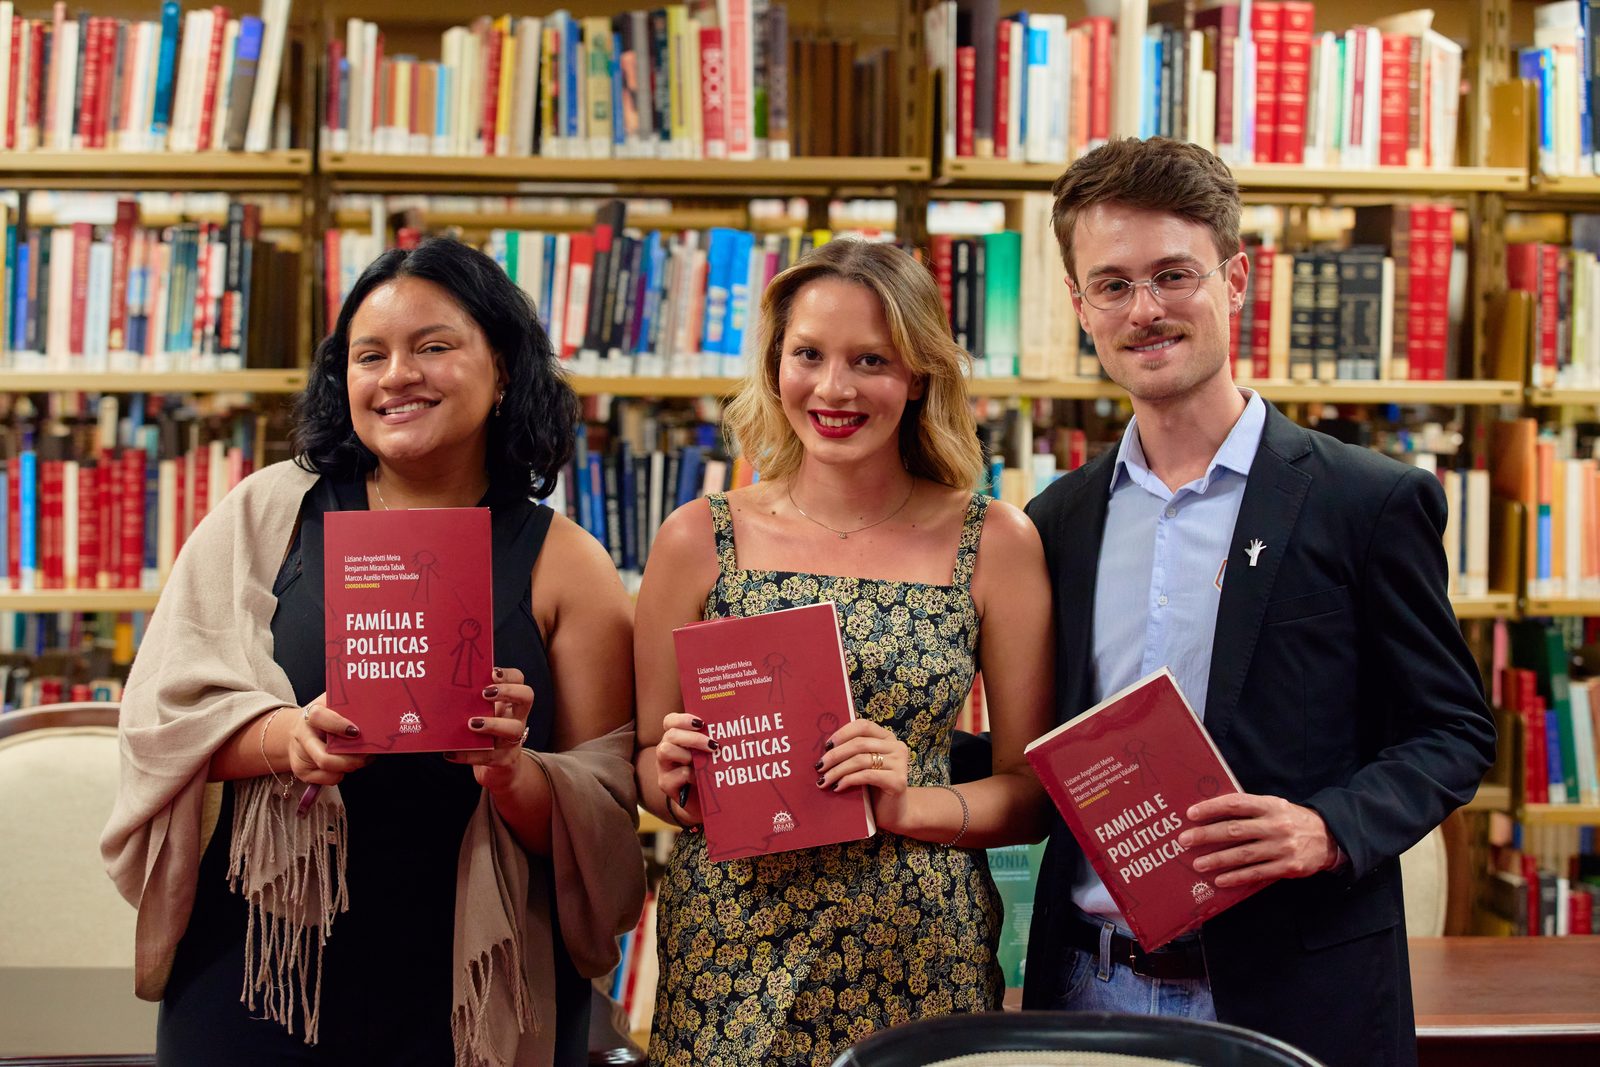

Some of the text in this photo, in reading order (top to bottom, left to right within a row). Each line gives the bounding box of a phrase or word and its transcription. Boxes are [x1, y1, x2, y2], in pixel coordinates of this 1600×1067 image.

[345, 565, 368, 573] Benjamin
[363, 555, 385, 563] Angelotti
[363, 573, 381, 581] Aurélio
[399, 572, 419, 580] Valadão
[346, 609, 424, 631] FAMÍLIA E
[347, 634, 429, 655] POLÍTICAS
[347, 659, 426, 680] PÚBLICAS
[697, 660, 752, 675] Liziane Angelotti Meira
[699, 668, 758, 684] Benjamin Miranda Tabak
[718, 682, 736, 690] Aurélio
[736, 680, 753, 688] Pereira
[752, 675, 773, 685] Valadão
[707, 712, 784, 740] FAMÍLIA E
[712, 736, 791, 764] POLÍTICAS
[1100, 756, 1115, 766] Meira
[715, 760, 791, 788] PÚBLICAS
[1074, 790, 1092, 803] Marcos
[1095, 793, 1168, 844] FAMÍLIA E
[1107, 812, 1182, 864] POLÍTICAS
[1120, 839, 1190, 884] PÚBLICA
